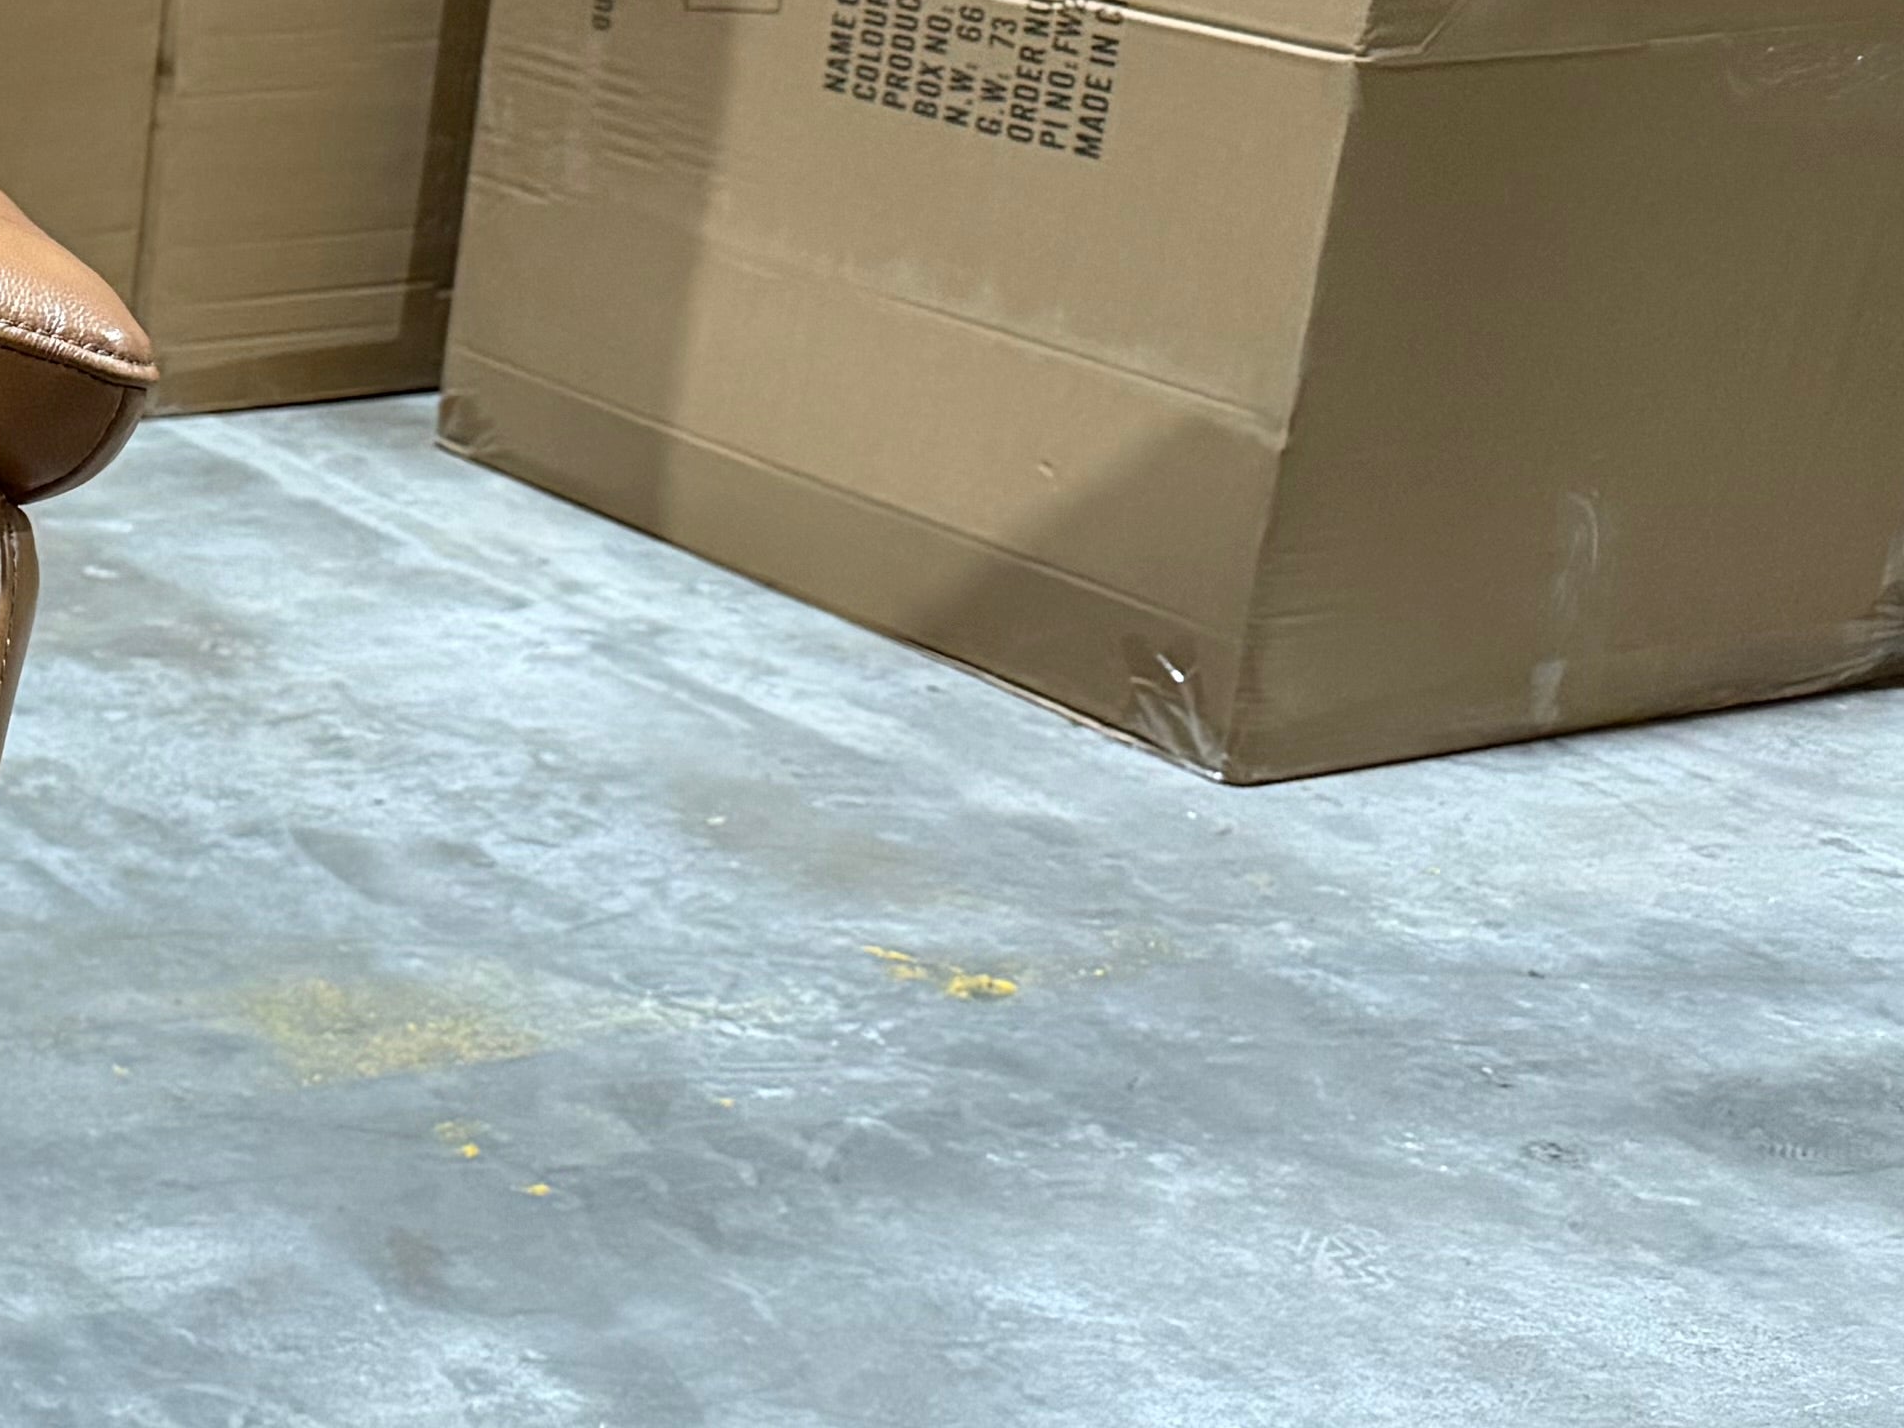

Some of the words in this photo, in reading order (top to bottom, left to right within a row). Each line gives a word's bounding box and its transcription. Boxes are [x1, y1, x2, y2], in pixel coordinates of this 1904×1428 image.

[824, 11, 859, 93] NAME
[956, 5, 985, 44] 66
[988, 16, 1018, 50] 73
[1090, 34, 1120, 68] IN
[912, 62, 943, 119] BOX
[1007, 45, 1045, 144] ORDER
[1074, 76, 1113, 160] MADE
